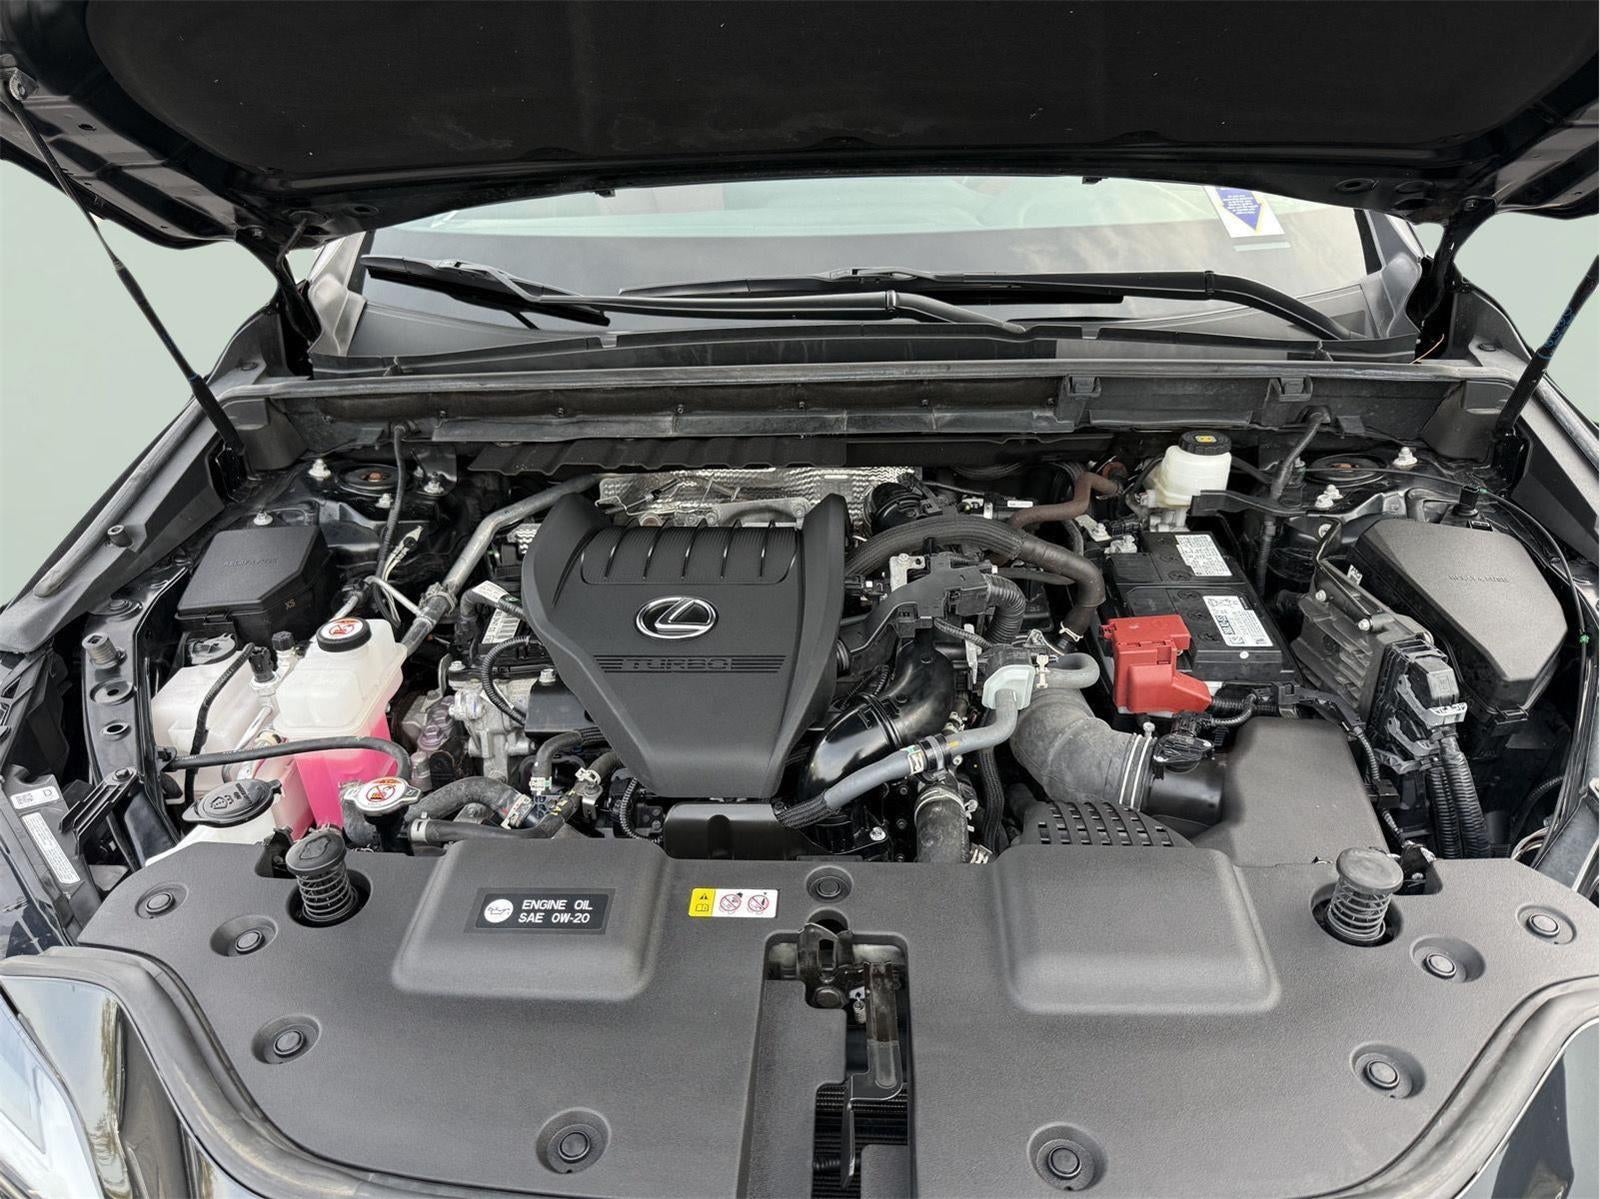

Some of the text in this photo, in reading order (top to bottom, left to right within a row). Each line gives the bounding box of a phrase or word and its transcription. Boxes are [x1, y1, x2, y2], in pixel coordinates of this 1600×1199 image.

[622, 657, 732, 671] TURBO
[521, 899, 594, 911] ENGINE OIL
[518, 912, 591, 924] SAE 0W-20
